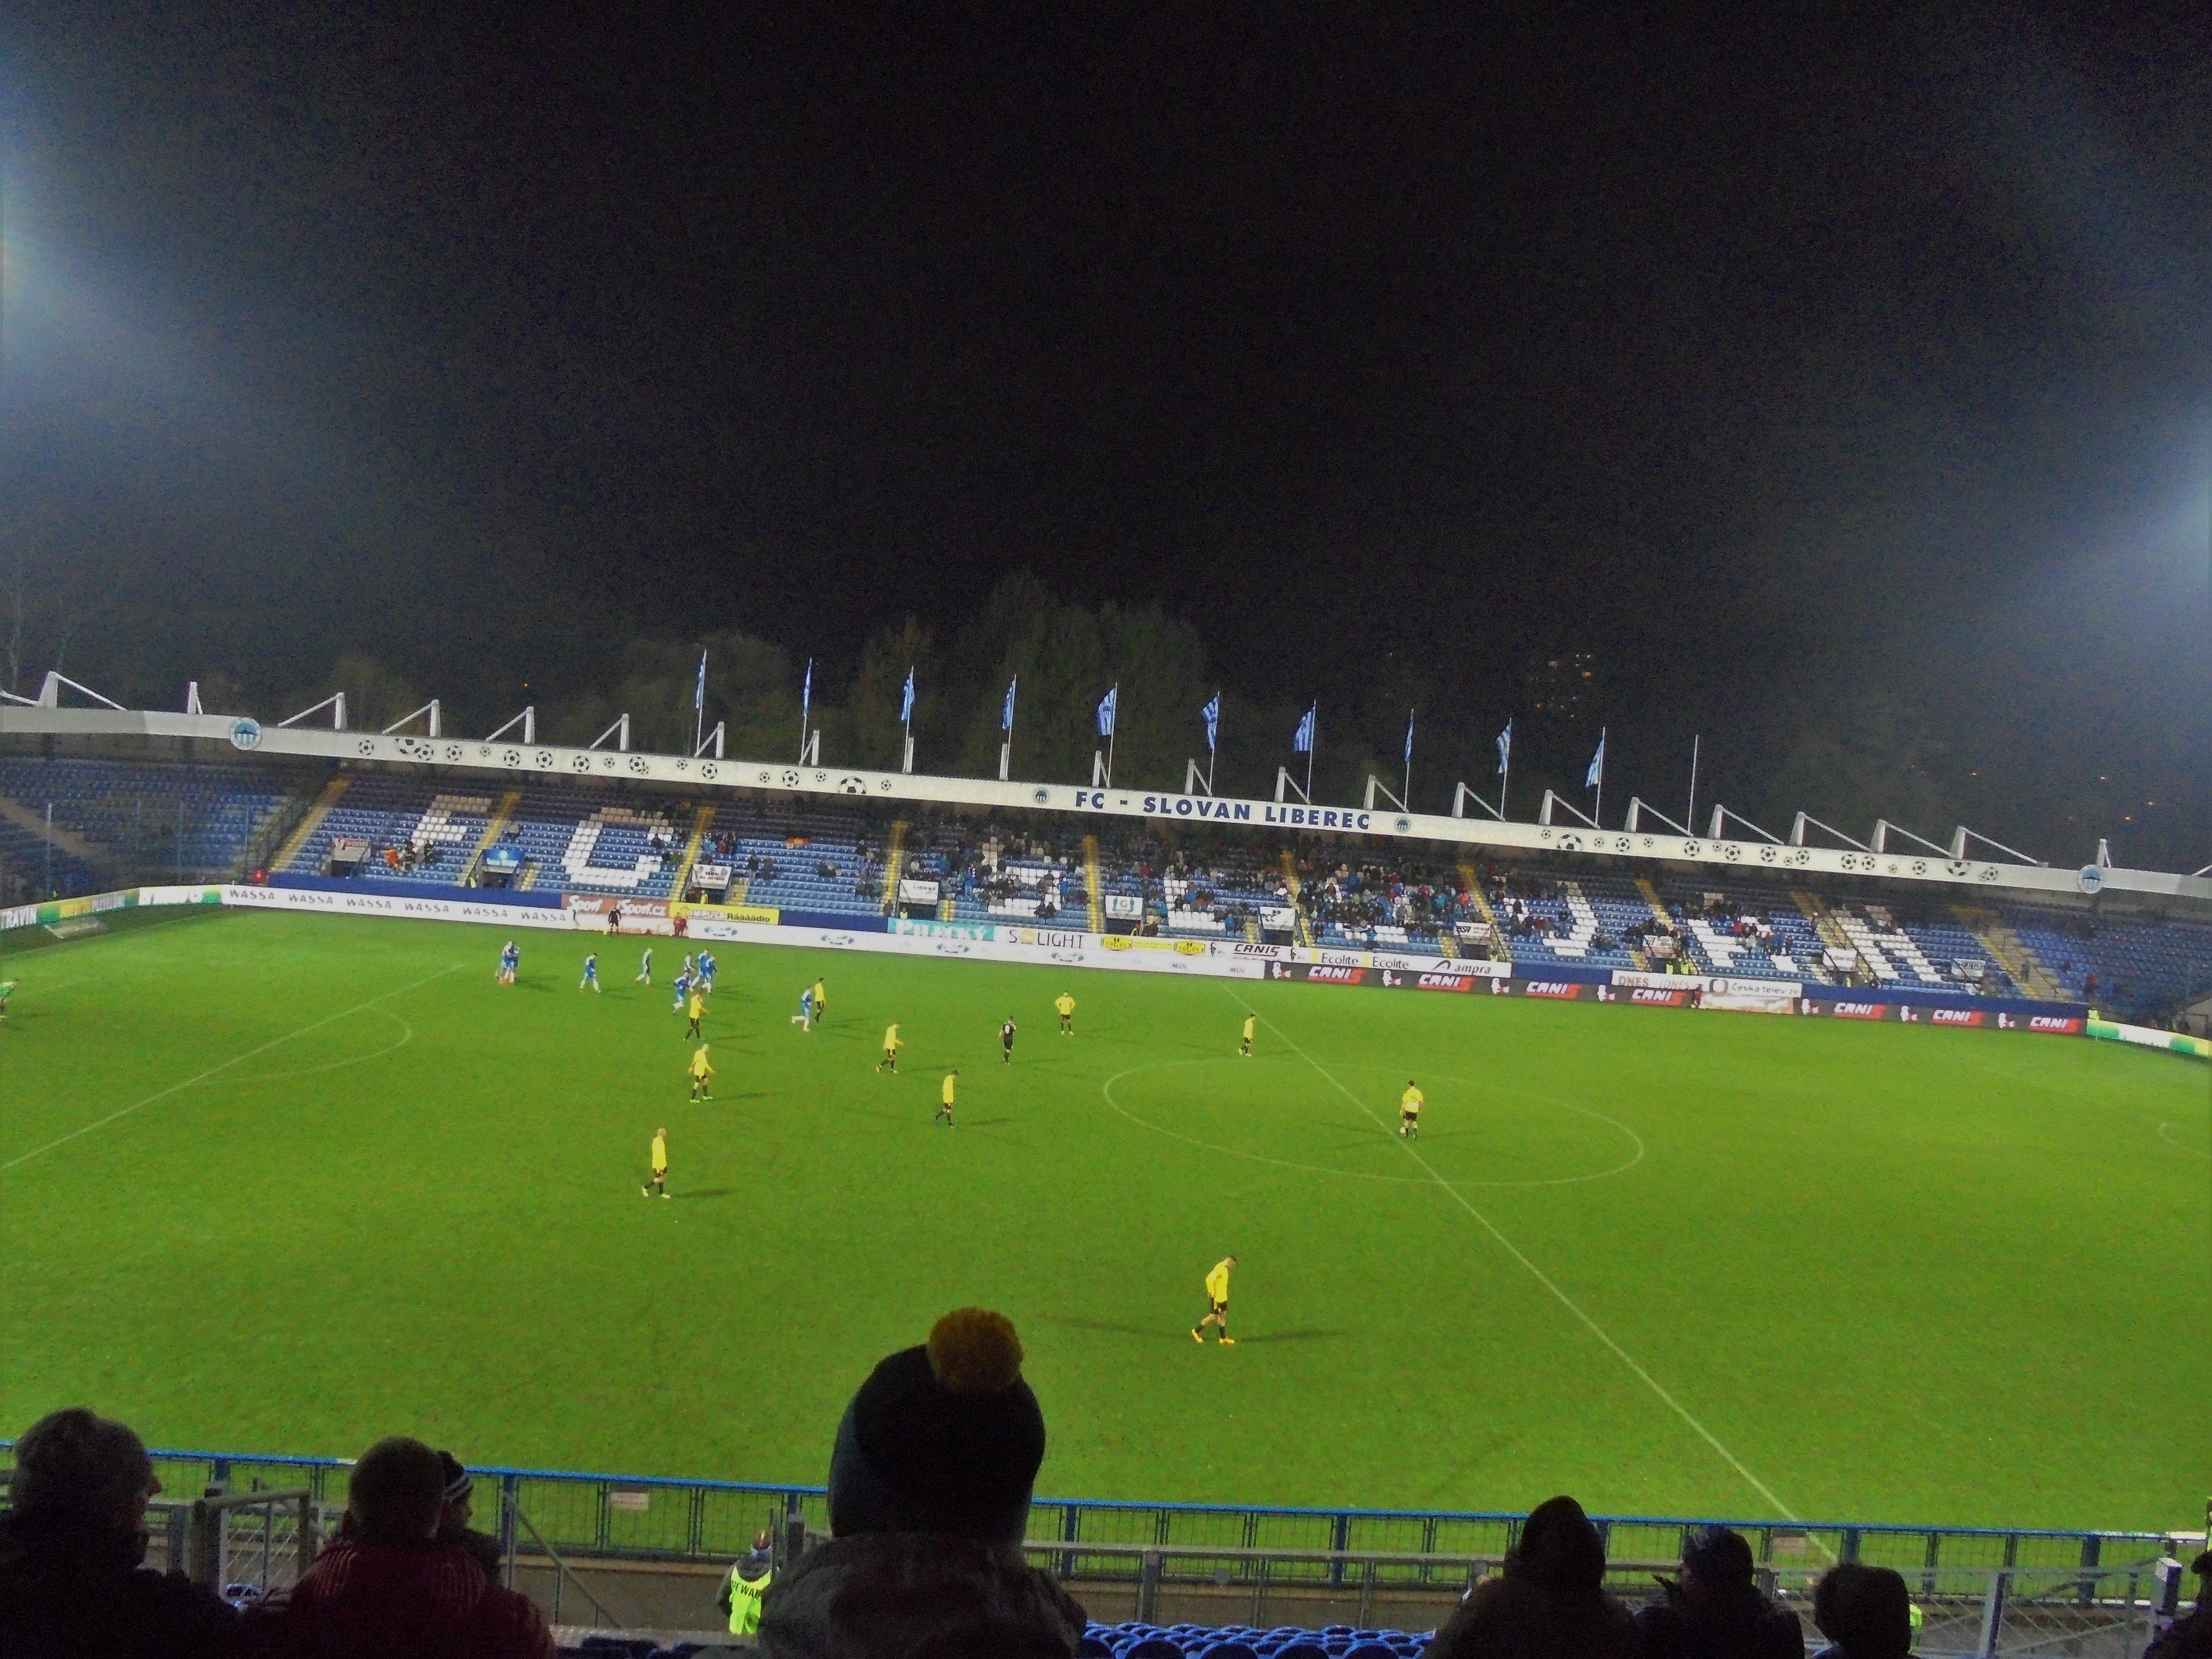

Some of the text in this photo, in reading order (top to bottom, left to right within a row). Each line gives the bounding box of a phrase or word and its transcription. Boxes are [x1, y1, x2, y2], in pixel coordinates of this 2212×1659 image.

[1076, 791, 1104, 808] FC
[1143, 796, 1250, 820] SLOVAN
[1265, 807, 1370, 830] LIBEREC
[229, 889, 275, 900] WASSA
[288, 894, 333, 905] WASSA
[346, 898, 392, 909] WASSA
[404, 902, 450, 913] WASSA
[462, 907, 508, 918] WASSA
[520, 911, 566, 922] WASSA
[1234, 943, 1280, 957] CANIS
[1322, 952, 1359, 966] Ecolite
[1373, 956, 1409, 969] Ecolite
[1454, 964, 1491, 975] ampra
